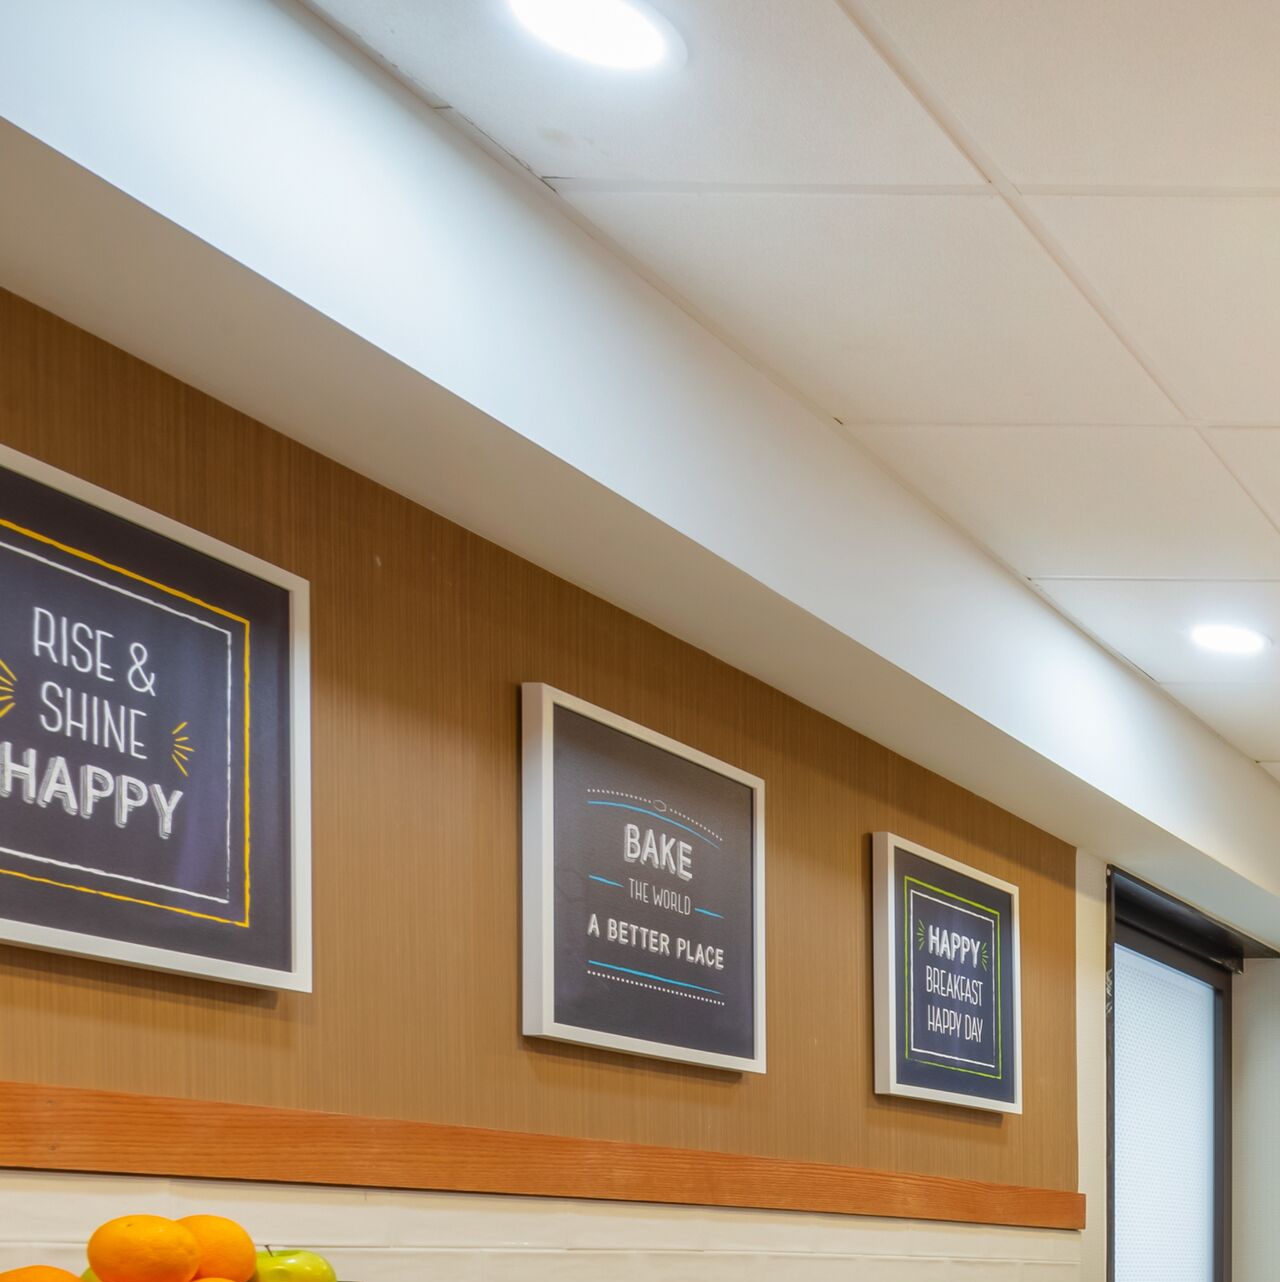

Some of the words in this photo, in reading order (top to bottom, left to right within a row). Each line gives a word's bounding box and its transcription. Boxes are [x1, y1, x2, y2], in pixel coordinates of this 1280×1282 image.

[33, 607, 114, 682] RISE
[128, 643, 156, 697] &
[40, 681, 148, 760] SHINE
[0, 741, 183, 840] HAPPY
[623, 823, 693, 881] BAKE
[629, 877, 649, 904] THE
[654, 885, 691, 916] WORLD
[588, 913, 600, 937] A
[607, 919, 670, 957] BETTER
[676, 938, 724, 970] PLACE
[928, 924, 981, 968] HAPPY
[926, 966, 983, 1008] BREAKFAST
[927, 1004, 961, 1041] HAPPY
[965, 1018, 983, 1044] DAY
